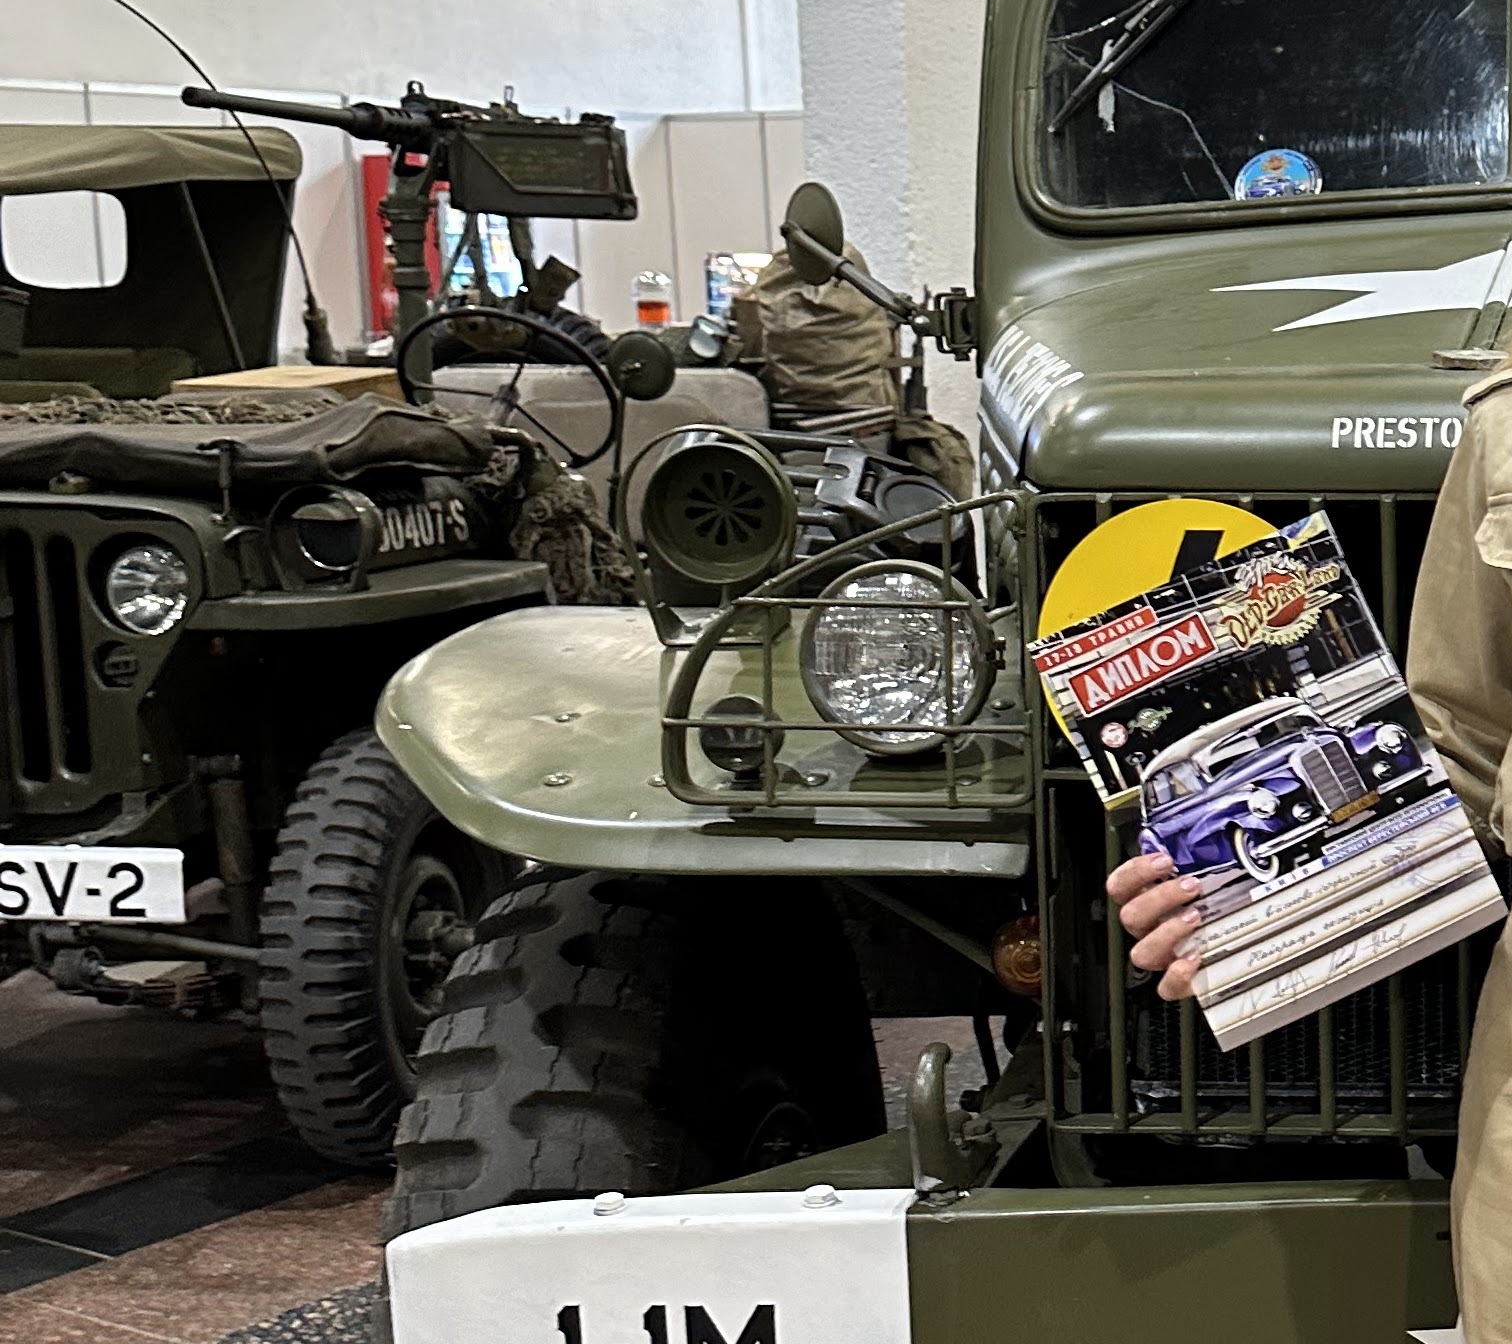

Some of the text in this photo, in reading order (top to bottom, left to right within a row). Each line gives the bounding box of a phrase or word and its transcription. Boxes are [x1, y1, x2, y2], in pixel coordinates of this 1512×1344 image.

[1332, 417, 1467, 449] PRESTO
[1086, 621, 1208, 708] ДИПЛОМ
[0, 861, 147, 918] SV-2
